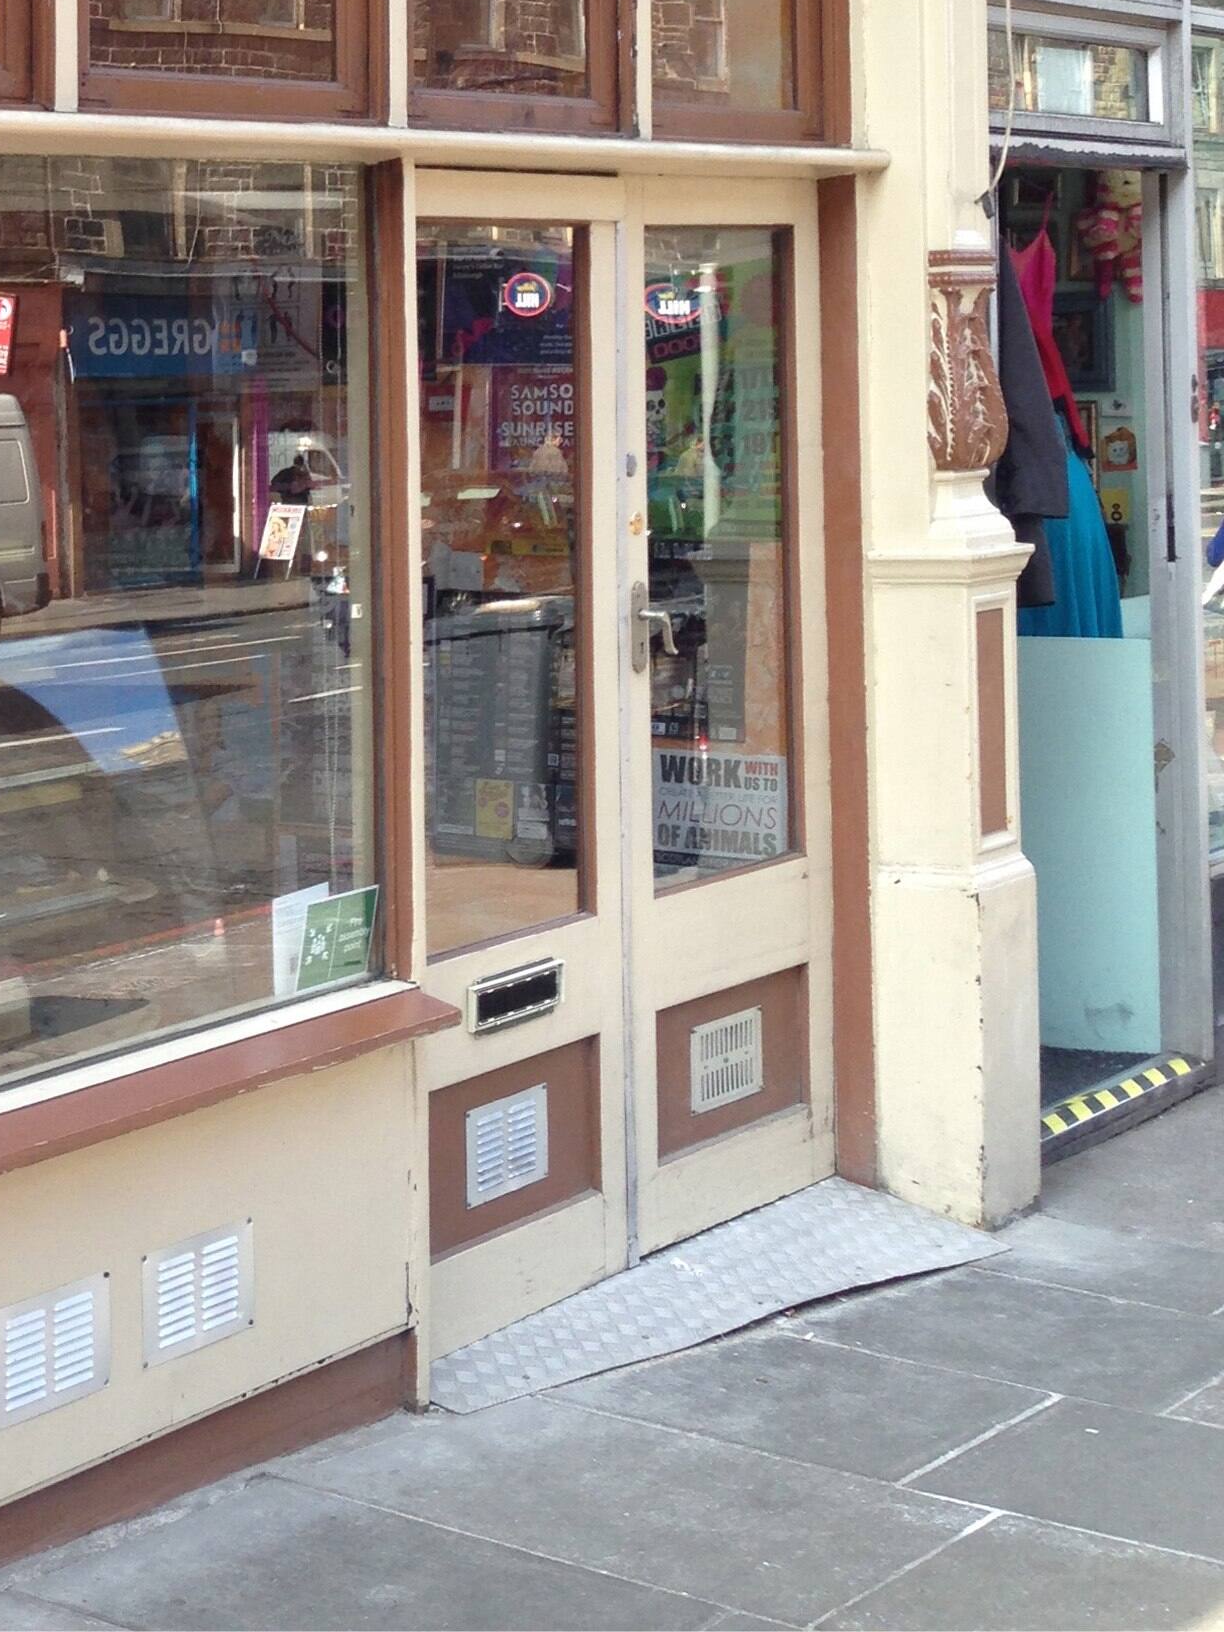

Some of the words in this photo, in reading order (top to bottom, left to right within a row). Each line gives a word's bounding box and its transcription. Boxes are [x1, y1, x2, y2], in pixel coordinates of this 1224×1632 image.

[512, 400, 574, 416] SOUND
[502, 421, 574, 437] SUNRISE
[660, 754, 742, 789] WORK
[745, 761, 779, 776] WITH
[744, 777, 760, 792] US
[762, 777, 779, 792] TO
[657, 799, 777, 830] MILLIONS
[657, 823, 681, 849] OF
[684, 825, 777, 858] ANIMALS
